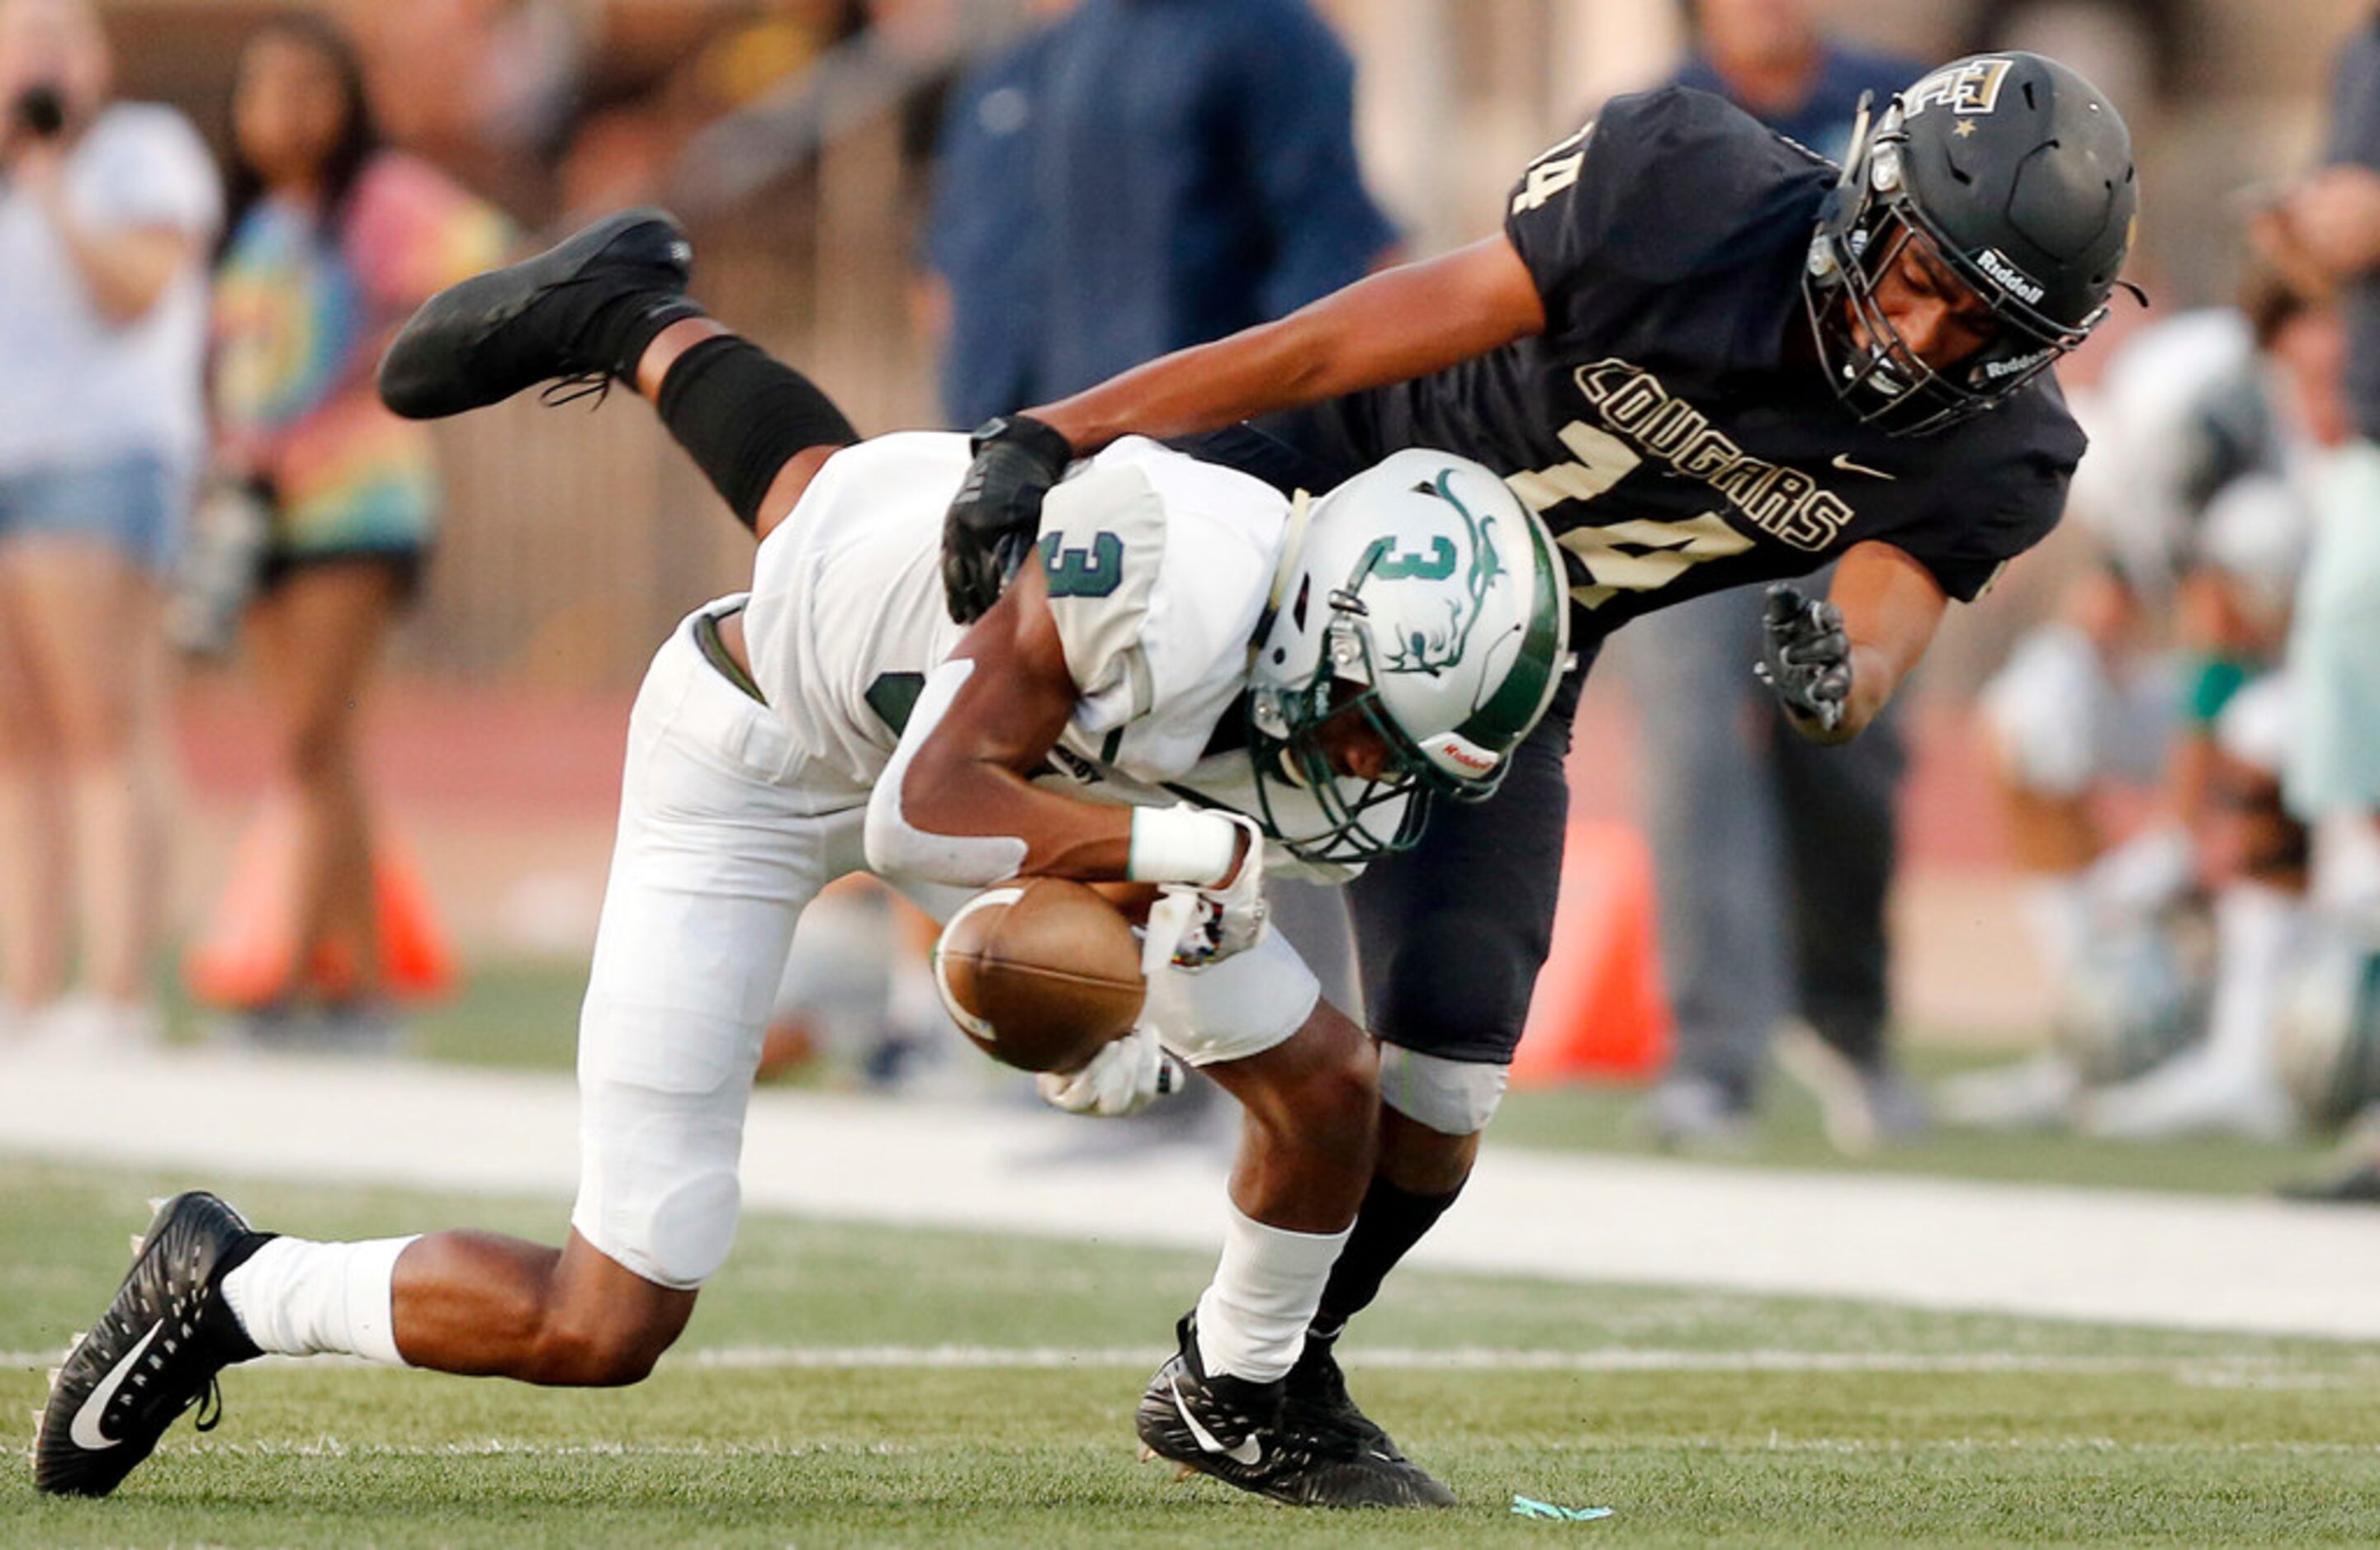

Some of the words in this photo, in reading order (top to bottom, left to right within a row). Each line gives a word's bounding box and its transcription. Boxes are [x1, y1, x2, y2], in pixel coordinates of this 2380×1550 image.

[1976, 249, 2045, 305] Riddell
[1573, 357, 1855, 551] COUGARS
[1039, 531, 1124, 598] 3
[1369, 535, 1457, 581] 3
